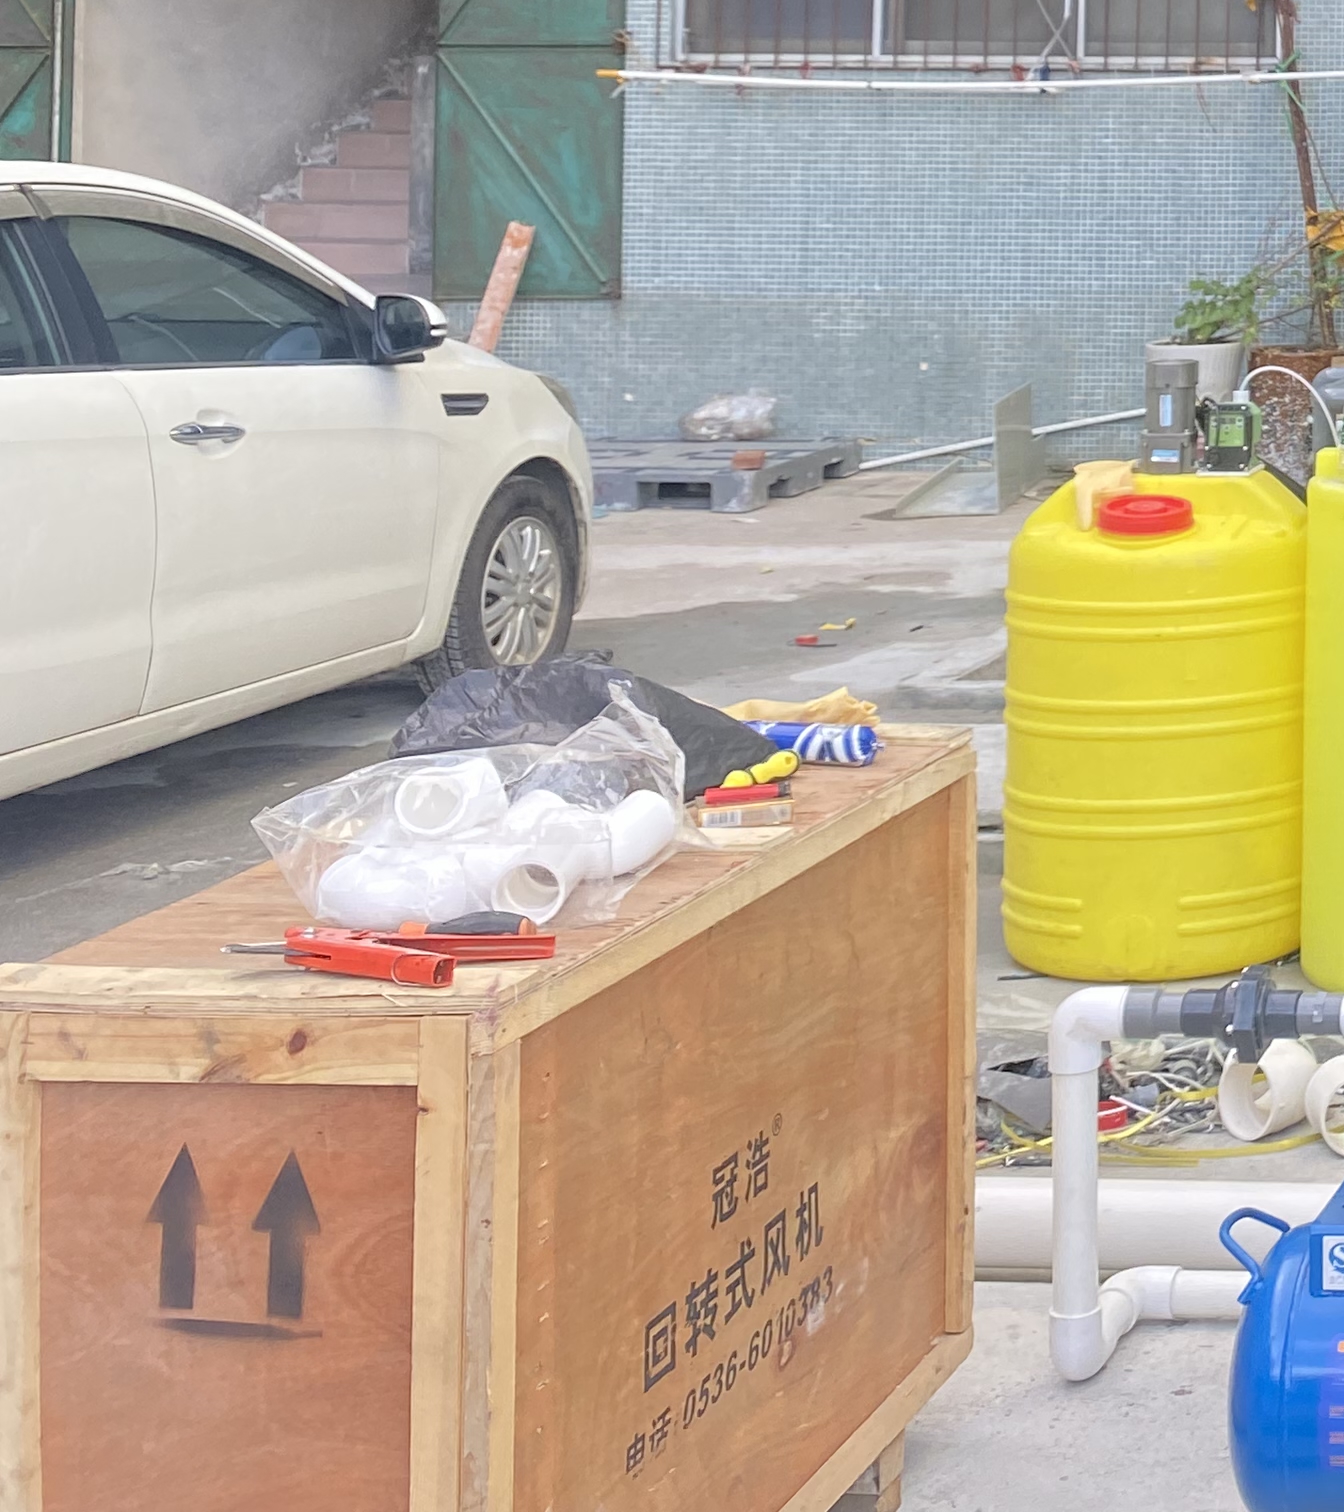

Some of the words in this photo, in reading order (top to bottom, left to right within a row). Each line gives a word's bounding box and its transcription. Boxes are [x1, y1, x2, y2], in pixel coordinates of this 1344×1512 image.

[710, 1129, 771, 1230] 冠浩
[642, 1180, 824, 1394] 回转式风机
